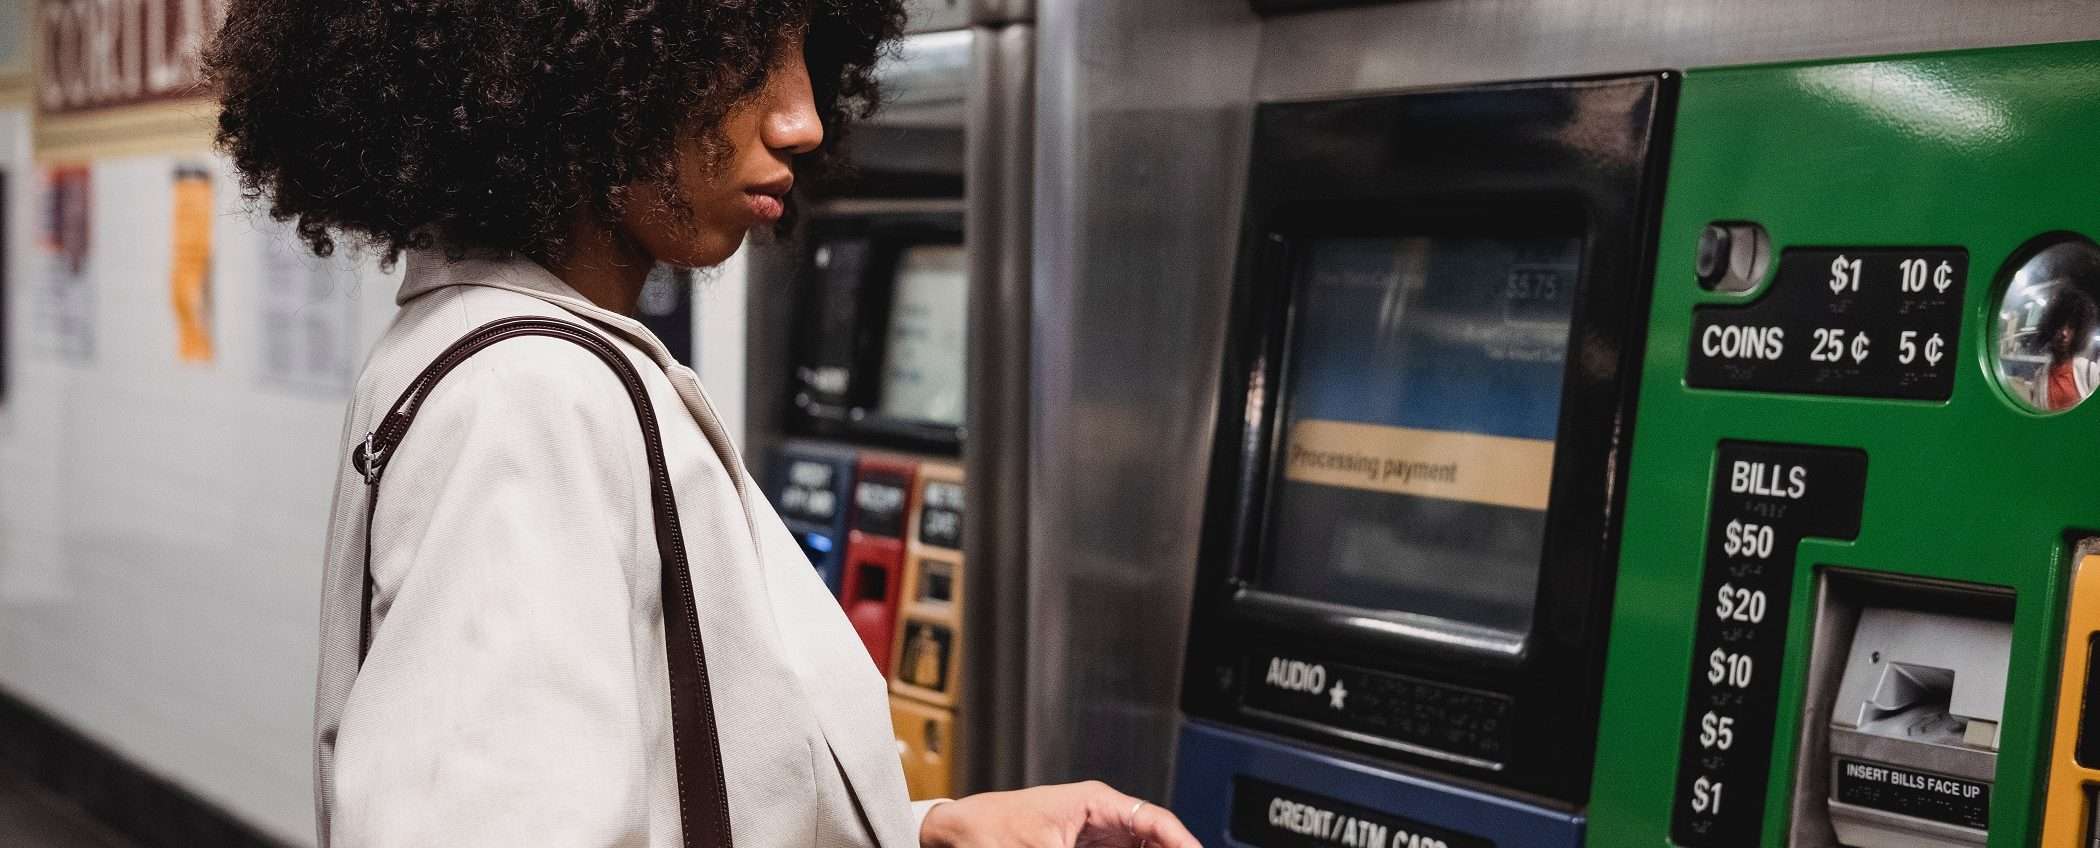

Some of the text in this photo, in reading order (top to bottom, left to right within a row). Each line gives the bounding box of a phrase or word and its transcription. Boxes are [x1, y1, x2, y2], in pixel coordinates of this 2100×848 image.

[1829, 254, 1953, 295] $1 10 ¢
[1702, 324, 1944, 367] COINS 25 ¢ 5 ¢
[1290, 444, 1458, 485] Processing payment
[1731, 460, 1807, 499] BILLS
[1724, 519, 1774, 559] $50
[1716, 583, 1766, 623] $20
[1266, 656, 1327, 695] AUDIO
[1707, 647, 1753, 688] $10
[1699, 710, 1735, 750] $5
[1691, 775, 1723, 815] $1
[1846, 763, 1981, 799] INSERT BILLS FACE UP
[1268, 797, 1388, 848] CREDIT/ATM
